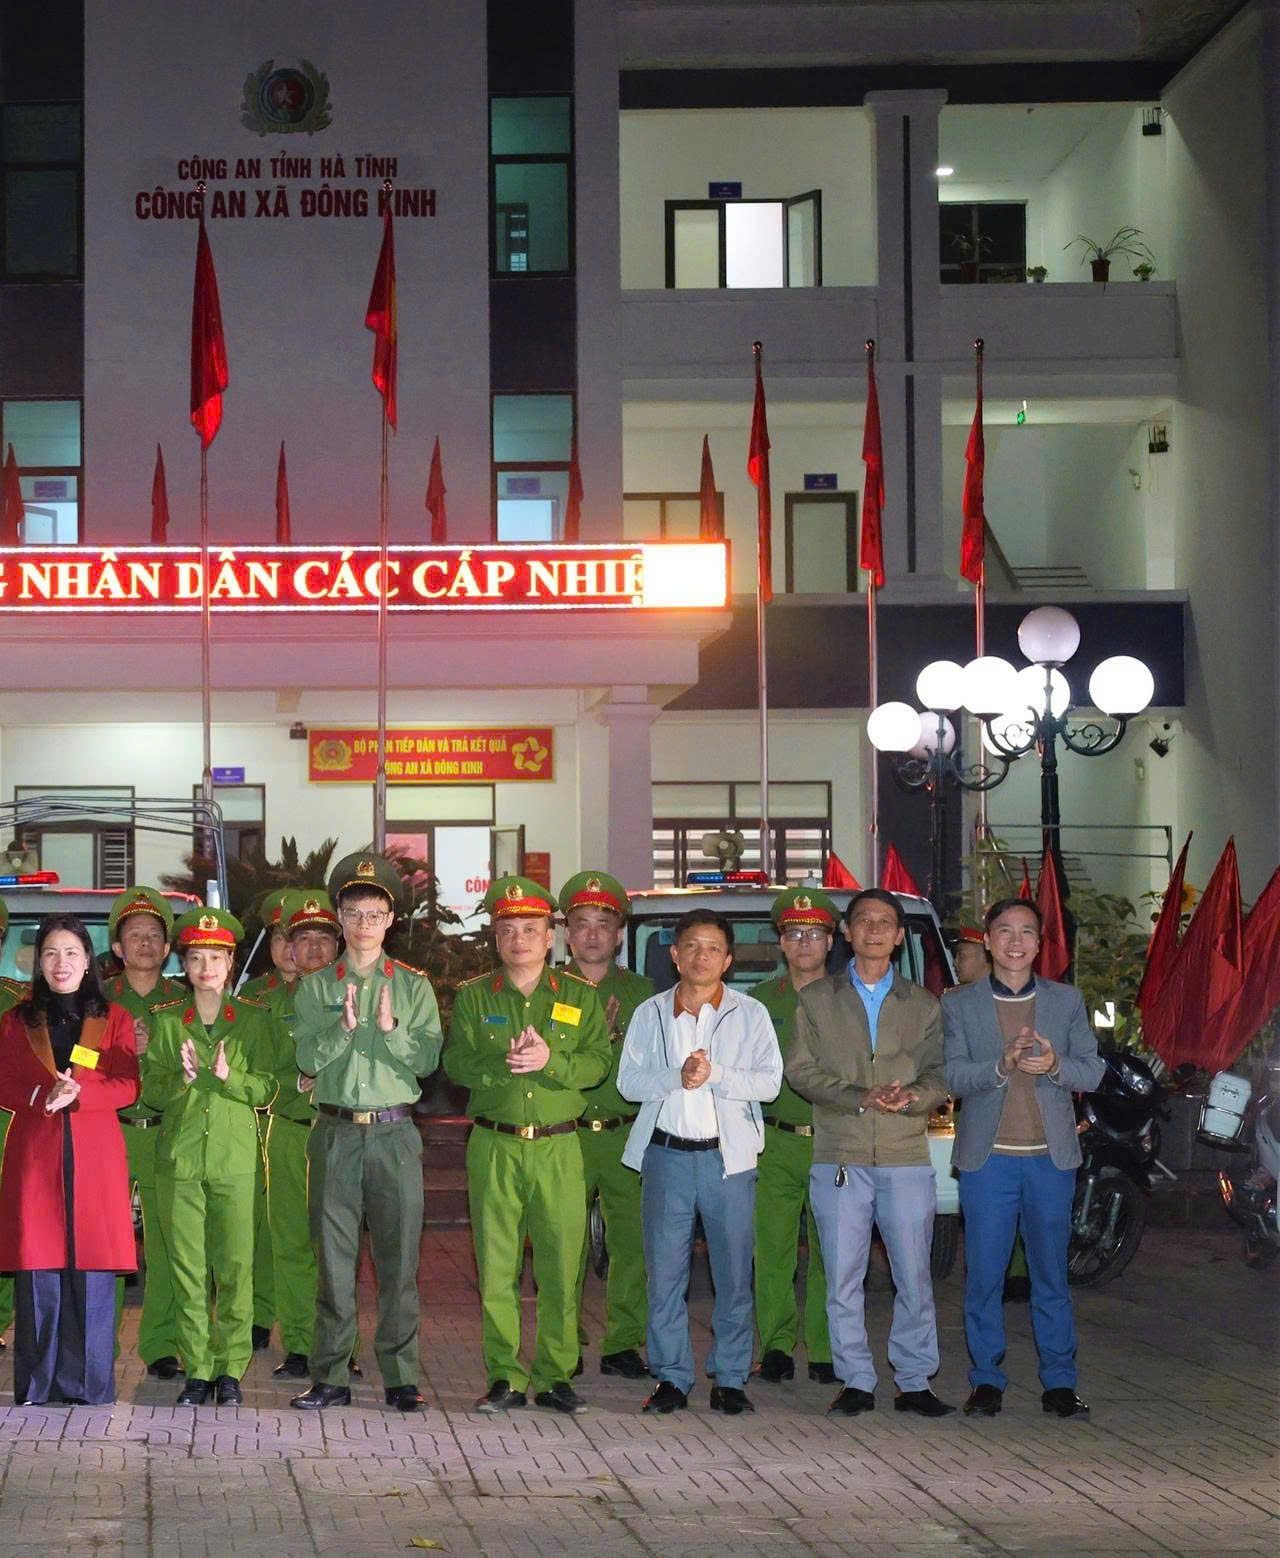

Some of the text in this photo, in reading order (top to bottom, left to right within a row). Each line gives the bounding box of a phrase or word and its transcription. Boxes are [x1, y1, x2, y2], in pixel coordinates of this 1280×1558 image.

[177, 150, 398, 180] CÔNG AN TỈNH HÀ TĨNH
[135, 185, 201, 219] CÔNG
[211, 190, 246, 218] AN
[255, 184, 290, 218] XÃ
[300, 183, 369, 218] ĐÔNG
[18, 551, 163, 599] NHÂN
[174, 550, 282, 598] DÂN
[293, 550, 400, 598] CÁC
[412, 550, 516, 598] CẤP
[396, 735, 415, 753] TIẾP
[416, 737, 436, 753] DÂN
[470, 735, 487, 753] KẾT
[379, 759, 403, 775] ÔNG
[405, 760, 418, 775] AN
[461, 760, 483, 775] KINH
